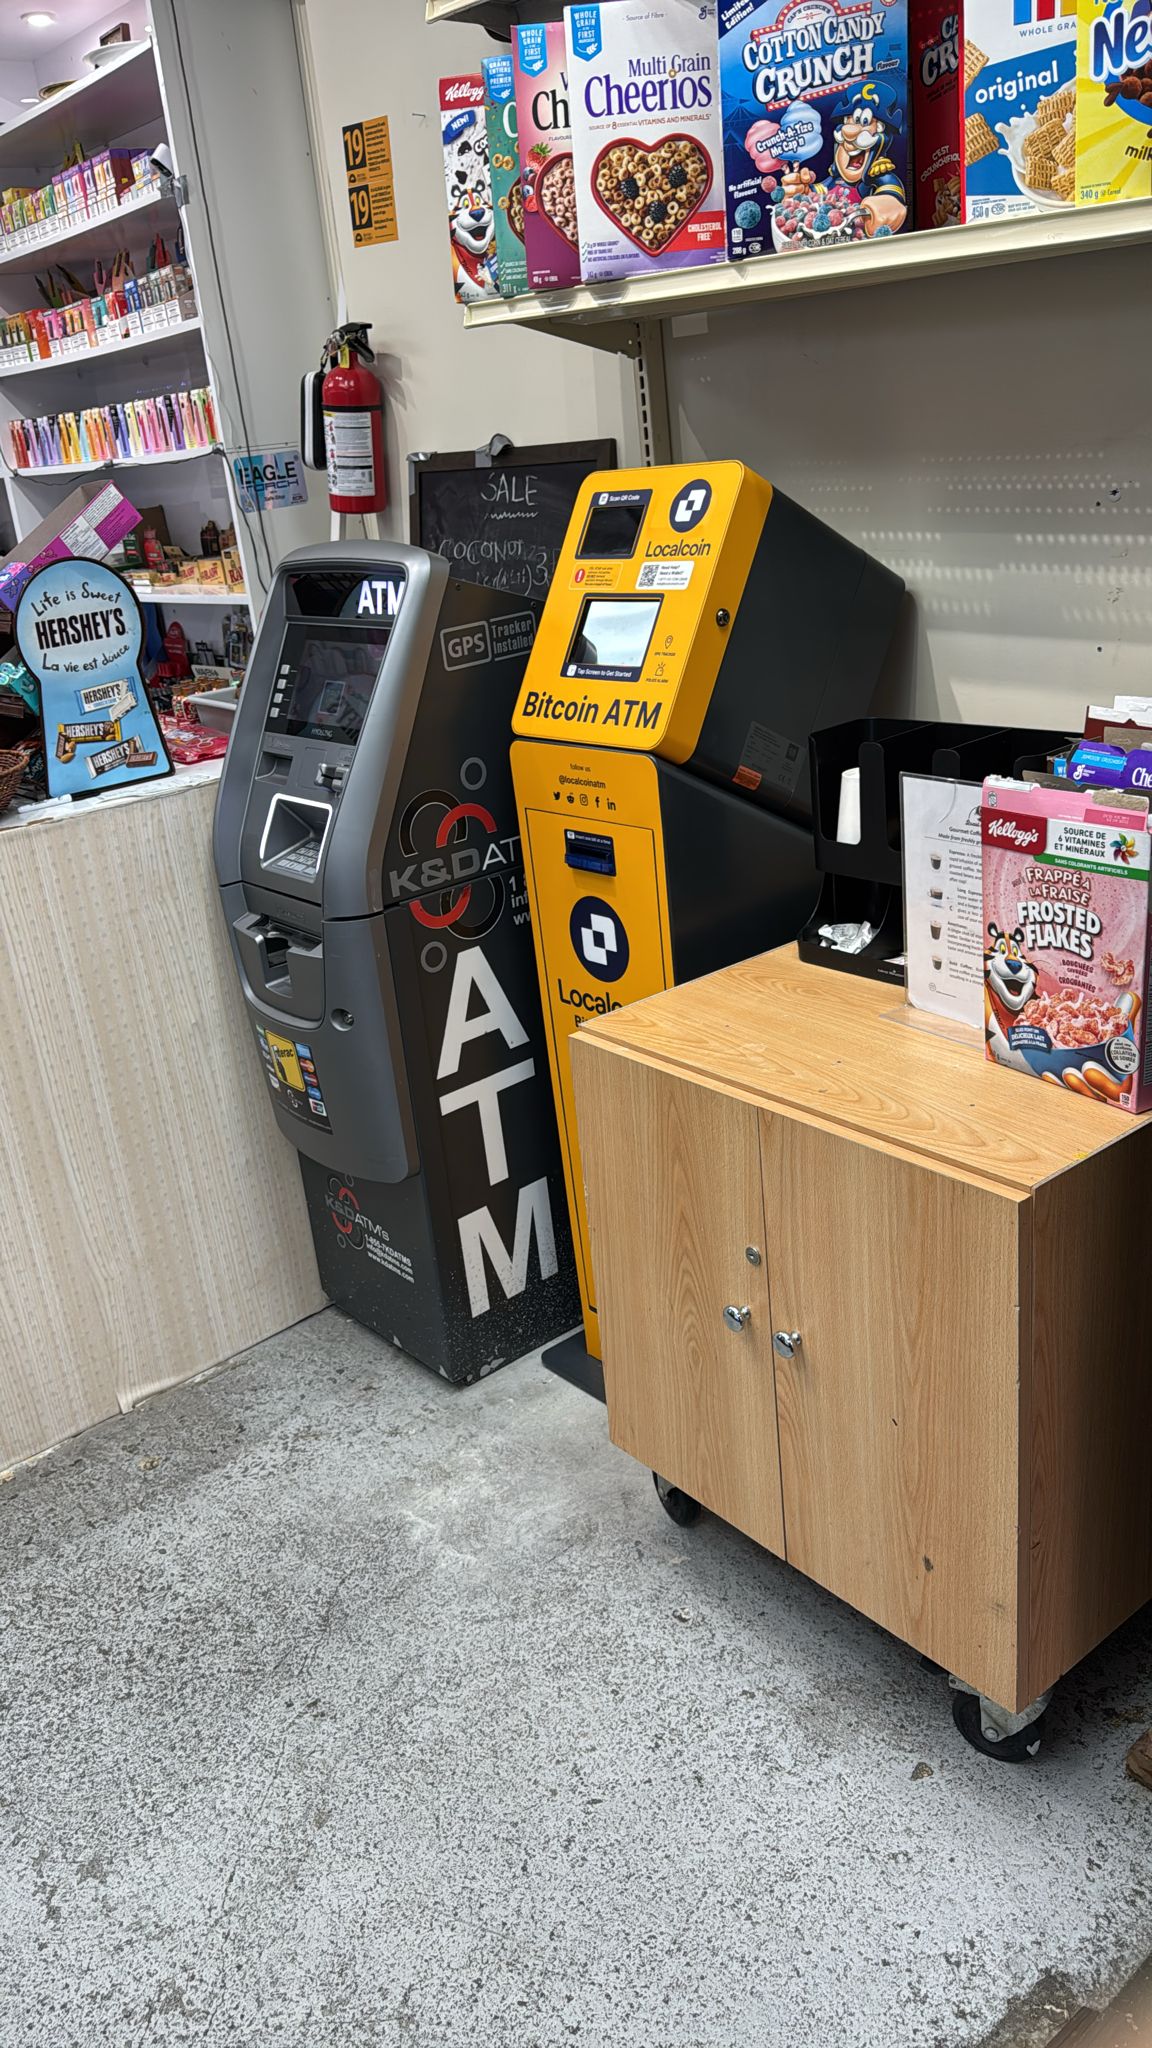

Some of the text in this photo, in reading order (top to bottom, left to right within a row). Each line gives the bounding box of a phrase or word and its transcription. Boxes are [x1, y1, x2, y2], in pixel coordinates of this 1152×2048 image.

[574, 11, 597, 20] WHOLE
[576, 18, 595, 27] GRAIN
[626, 13, 643, 21] Source
[651, 11, 664, 19] Fibre
[726, 3, 755, 30] Edition!
[521, 29, 543, 38] WHOLE
[523, 36, 542, 46] GRAIN
[578, 30, 595, 39] FIRST
[1019, 26, 1053, 37] WHOLE
[743, 11, 886, 72] COTTON CANDY
[524, 47, 541, 56] FIRST
[628, 53, 711, 77] Multi Grain
[754, 43, 875, 103] CRUNCH
[876, 59, 900, 71] Flavour
[445, 82, 484, 102] Kellogg
[975, 60, 1059, 105] original
[584, 73, 712, 118] Cheerios
[451, 114, 469, 131] NEW!
[638, 117, 666, 127] VITAMINS
[344, 128, 364, 167] 19
[770, 146, 782, 158] Me
[728, 184, 737, 192] No
[734, 187, 757, 199] flavours
[1081, 190, 1094, 200] 340
[350, 190, 369, 226] 19
[480, 472, 540, 506] SALE
[645, 538, 711, 557] Localcoin
[31, 582, 122, 617] Life is Sweet
[357, 580, 405, 615] ATM
[35, 607, 127, 650] HERSHEY'S
[448, 618, 532, 659] GPS Tracker
[493, 634, 534, 655] Installed
[42, 644, 130, 673] La vie est douce
[83, 683, 122, 704] HERSHEY'S
[522, 691, 662, 730] Bitcoin ATM
[66, 723, 104, 738] HERSHEY'S
[93, 742, 131, 768] HERSHEY'S
[559, 775, 607, 789] @localcoinatm
[949, 826, 969, 834] Gourmet
[988, 818, 1039, 847] Kellogg's
[1064, 827, 1106, 840] SOURCE DE
[961, 836, 975, 844] freshly
[1065, 836, 1106, 849] VITAMINES
[1054, 843, 1105, 858] ET MINÉRAUX
[1055, 858, 1128, 876] SANS COLORANTS ARTIFICIELS
[1025, 867, 1082, 888] FRAPPÉ
[1029, 884, 1091, 907] LA FRAISE
[1017, 901, 1102, 936] FROSTED
[1026, 925, 1093, 959] FLAKES
[1058, 976, 1097, 994] CROQUANTES
